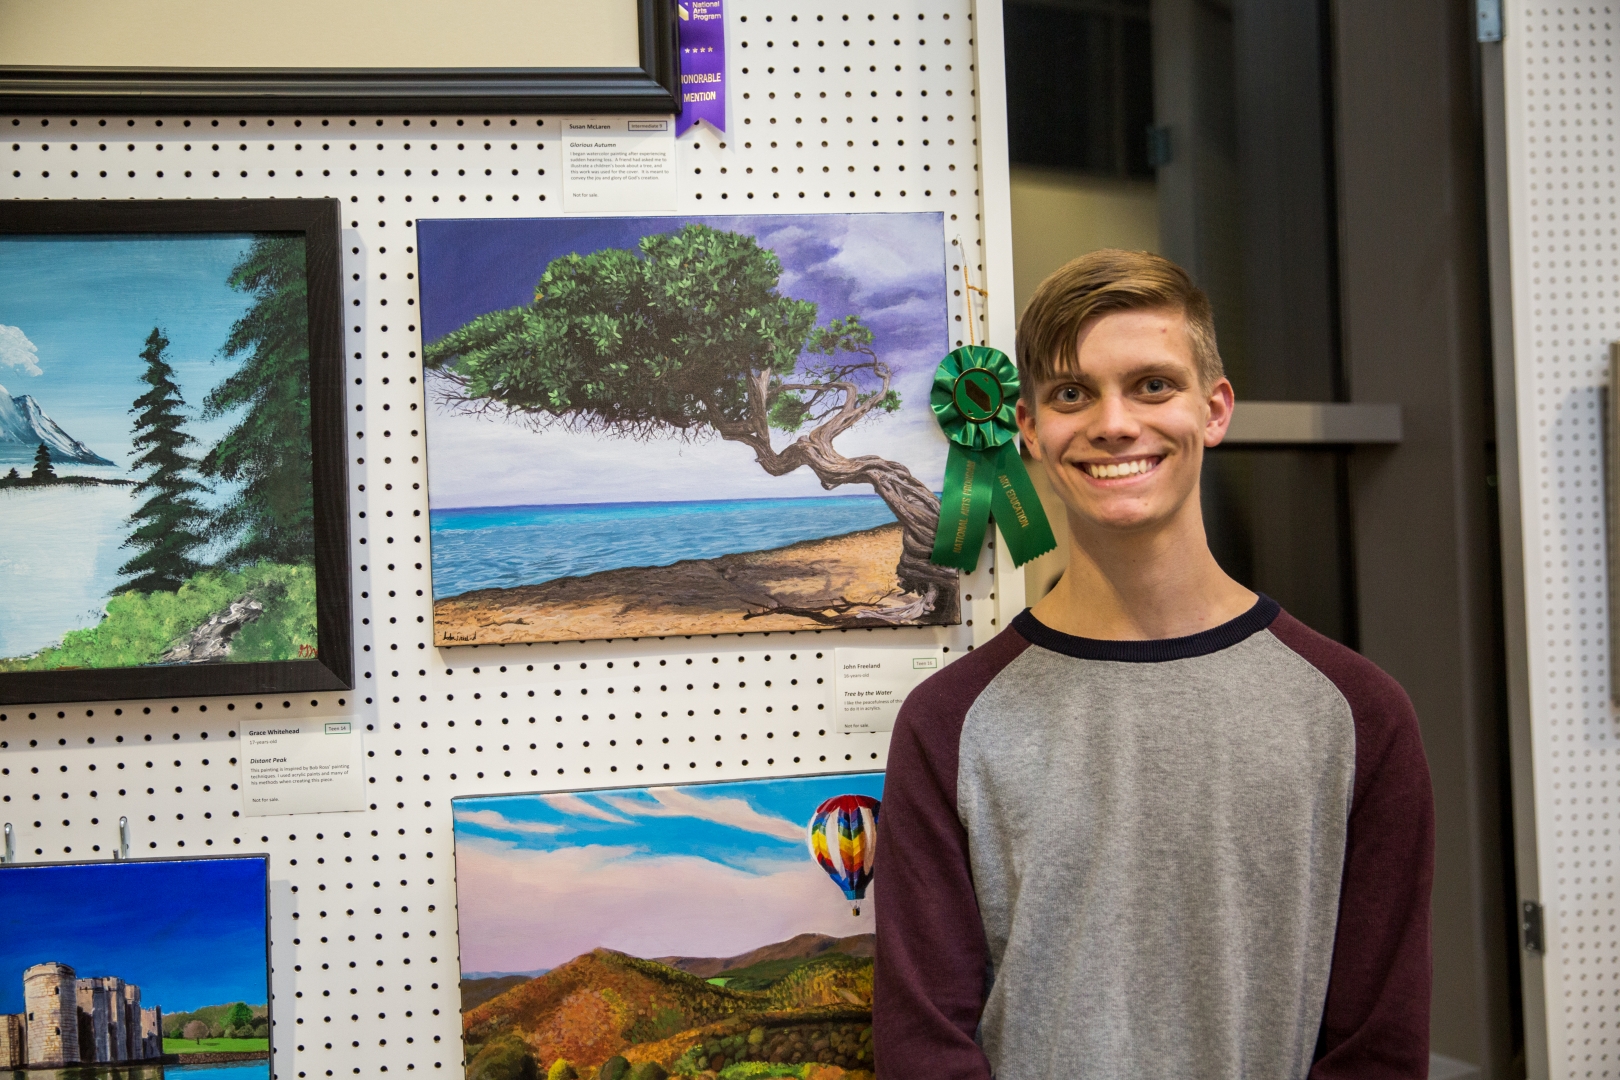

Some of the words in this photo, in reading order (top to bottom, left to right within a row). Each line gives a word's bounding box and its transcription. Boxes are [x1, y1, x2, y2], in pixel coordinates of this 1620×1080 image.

[684, 92, 716, 102] MENTION
[963, 460, 975, 496] PROGRAM
[960, 497, 971, 514] ARTS
[998, 475, 1012, 489] ART
[1006, 488, 1030, 528] EDUCATION
[953, 518, 969, 554] NATIONAL
